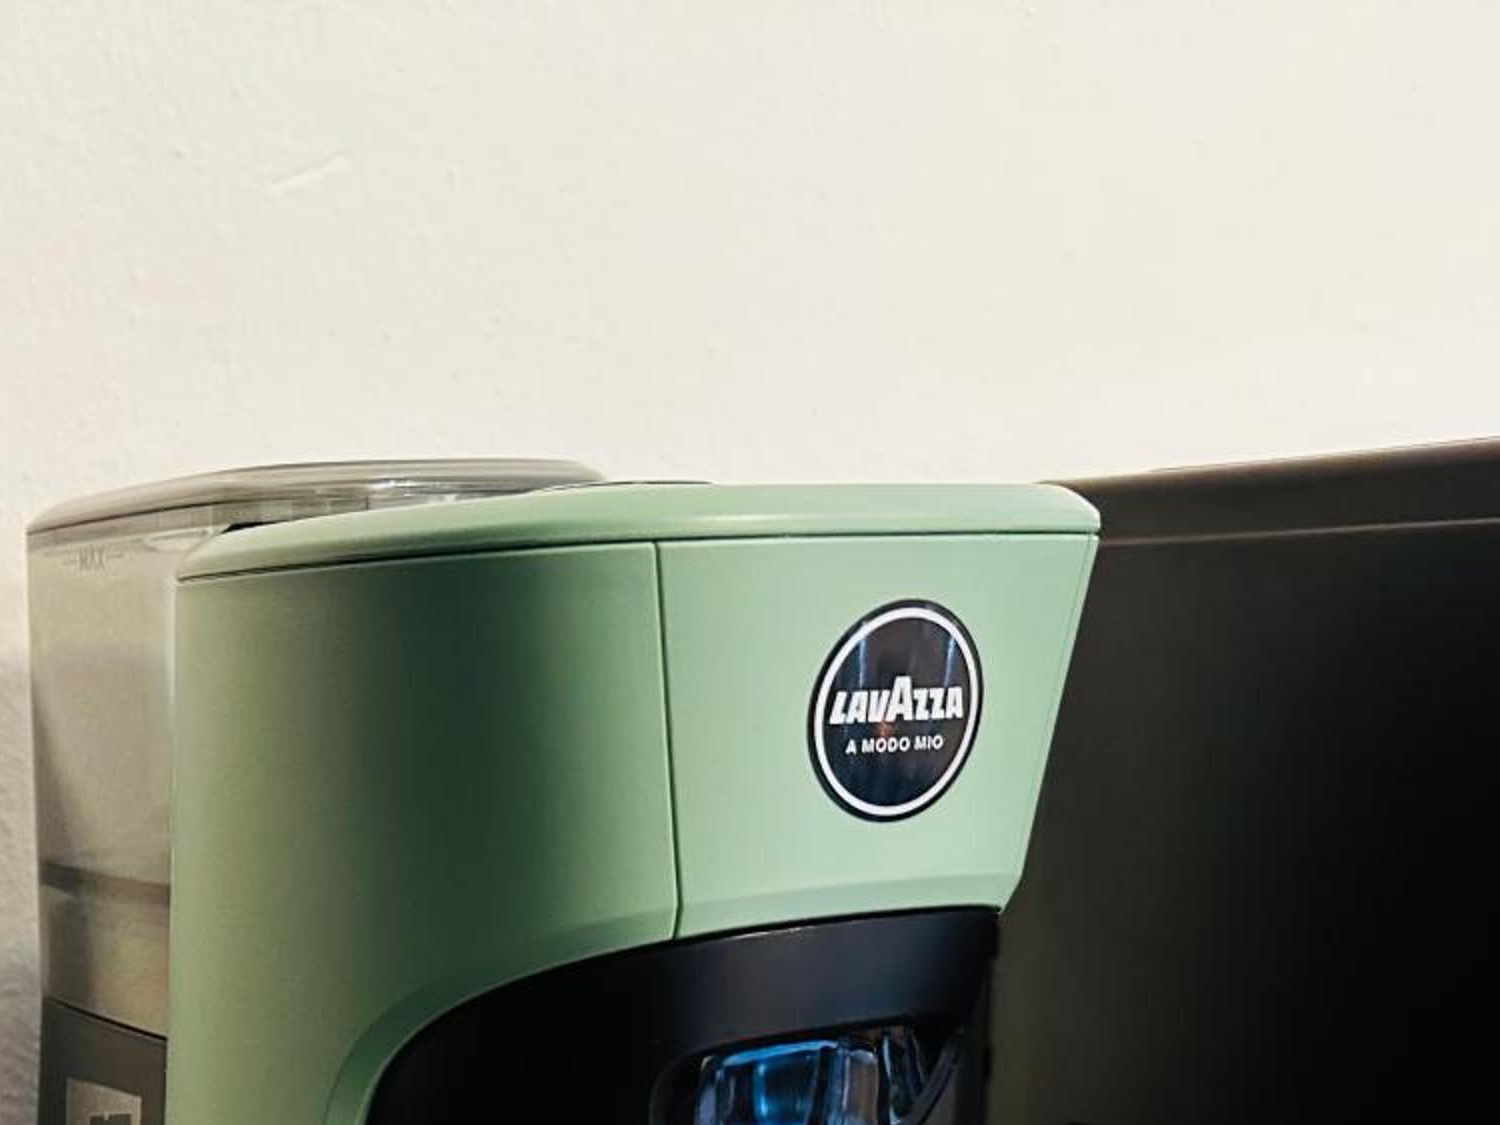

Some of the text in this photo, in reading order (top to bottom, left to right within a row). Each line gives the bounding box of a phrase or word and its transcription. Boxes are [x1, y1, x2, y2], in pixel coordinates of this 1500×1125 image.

[829, 675, 964, 725] LAVAZZA
[845, 734, 944, 755] A MODO MIO
